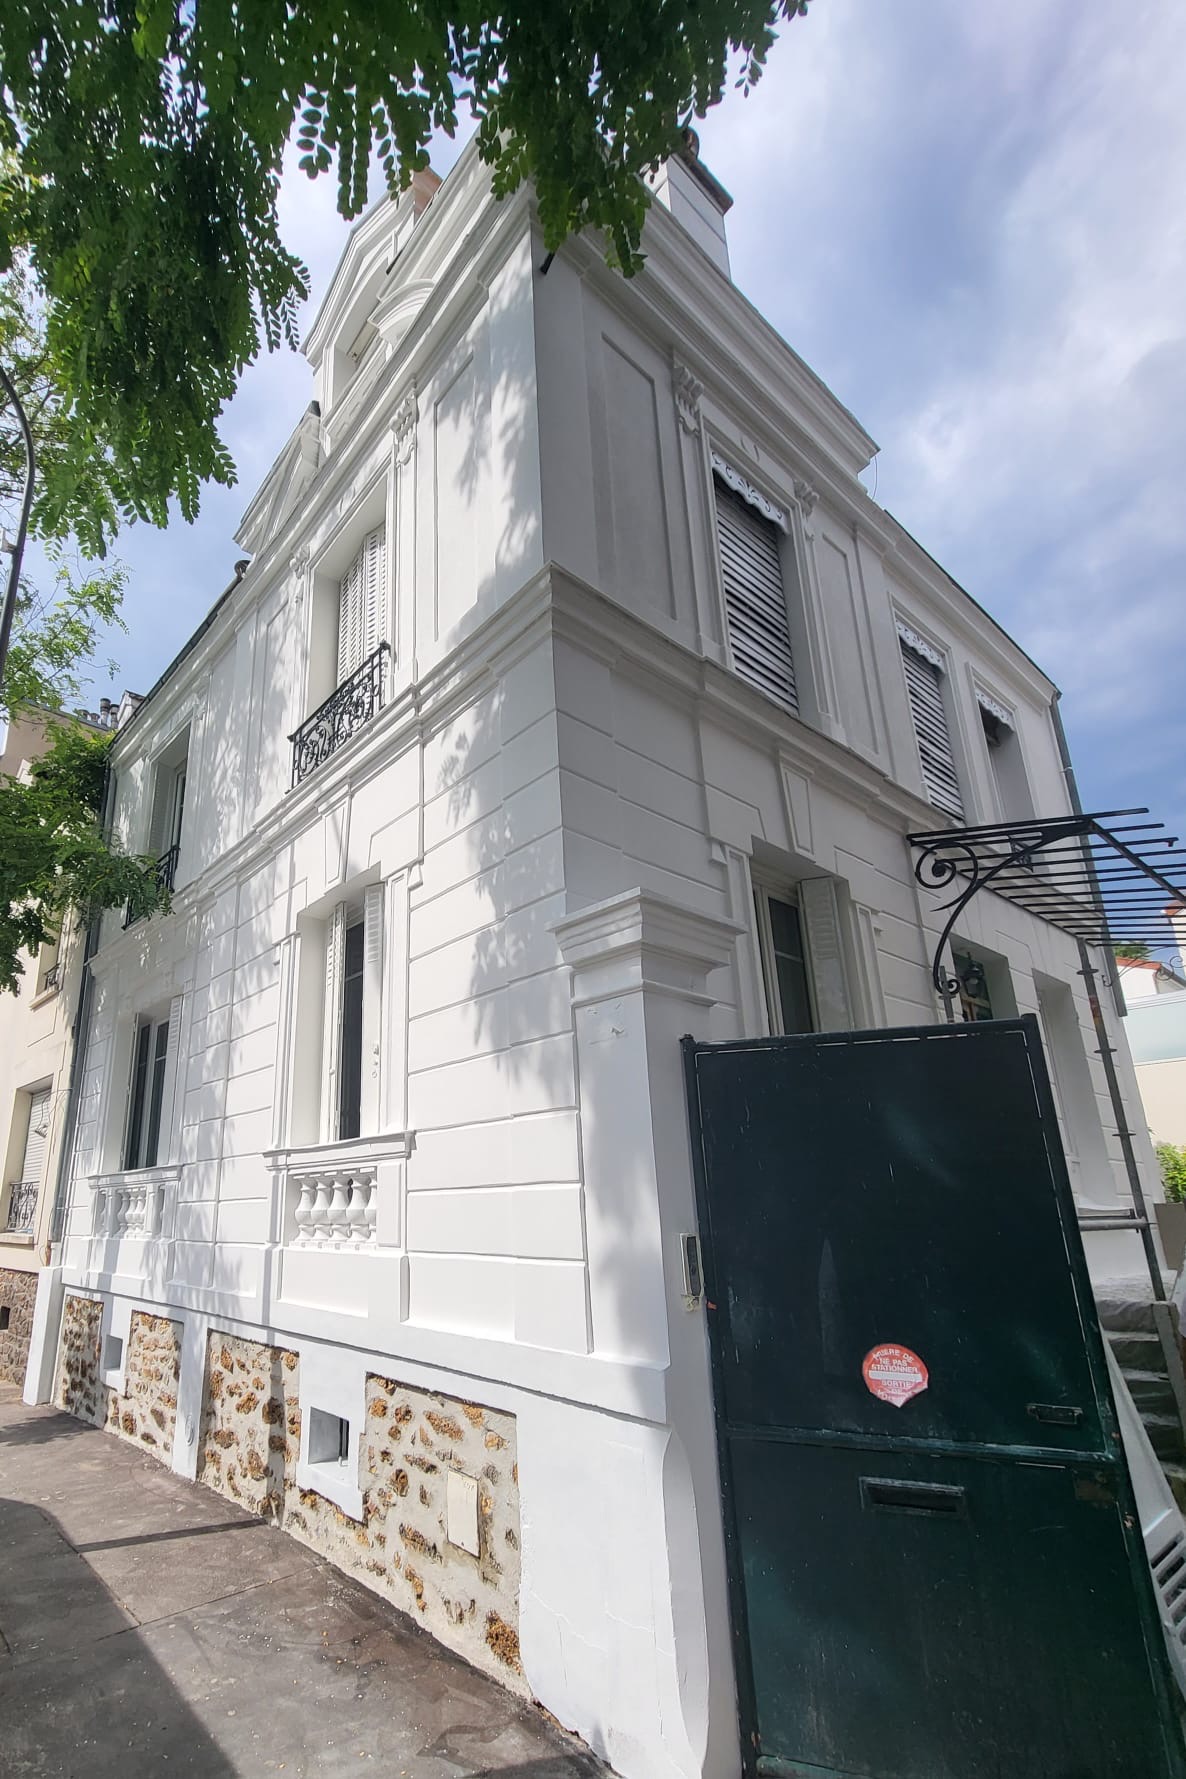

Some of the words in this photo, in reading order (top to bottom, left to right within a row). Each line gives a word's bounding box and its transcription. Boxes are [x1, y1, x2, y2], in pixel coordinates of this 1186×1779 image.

[903, 1353, 914, 1363] DE
[892, 1359, 908, 1367] PAS
[871, 1363, 919, 1374] STATIONNER
[882, 1380, 912, 1388] SORTIE
